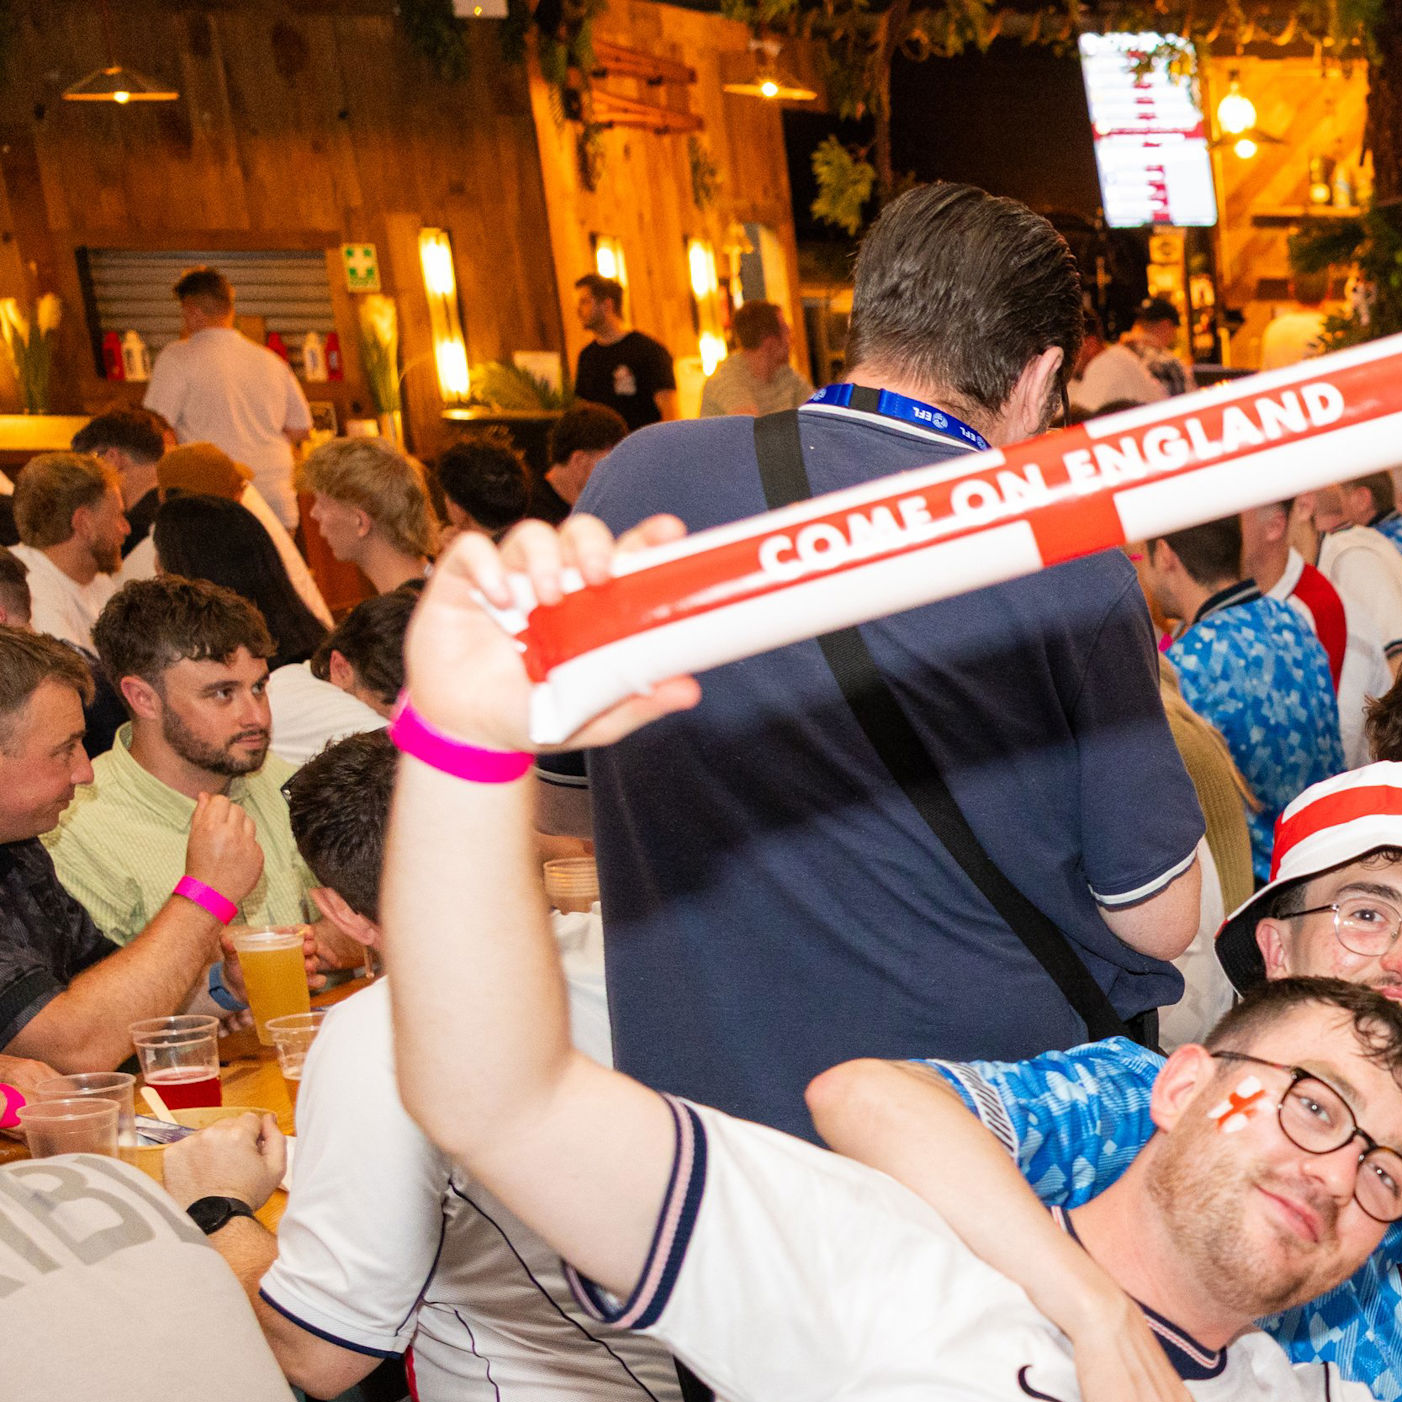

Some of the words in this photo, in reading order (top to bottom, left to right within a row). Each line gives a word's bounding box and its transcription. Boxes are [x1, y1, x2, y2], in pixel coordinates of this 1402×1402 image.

[912, 406, 931, 422] EFL
[959, 426, 977, 441] EFL
[758, 494, 930, 574] COME
[951, 462, 1051, 520] ON
[1062, 381, 1345, 489] ENGLAND
